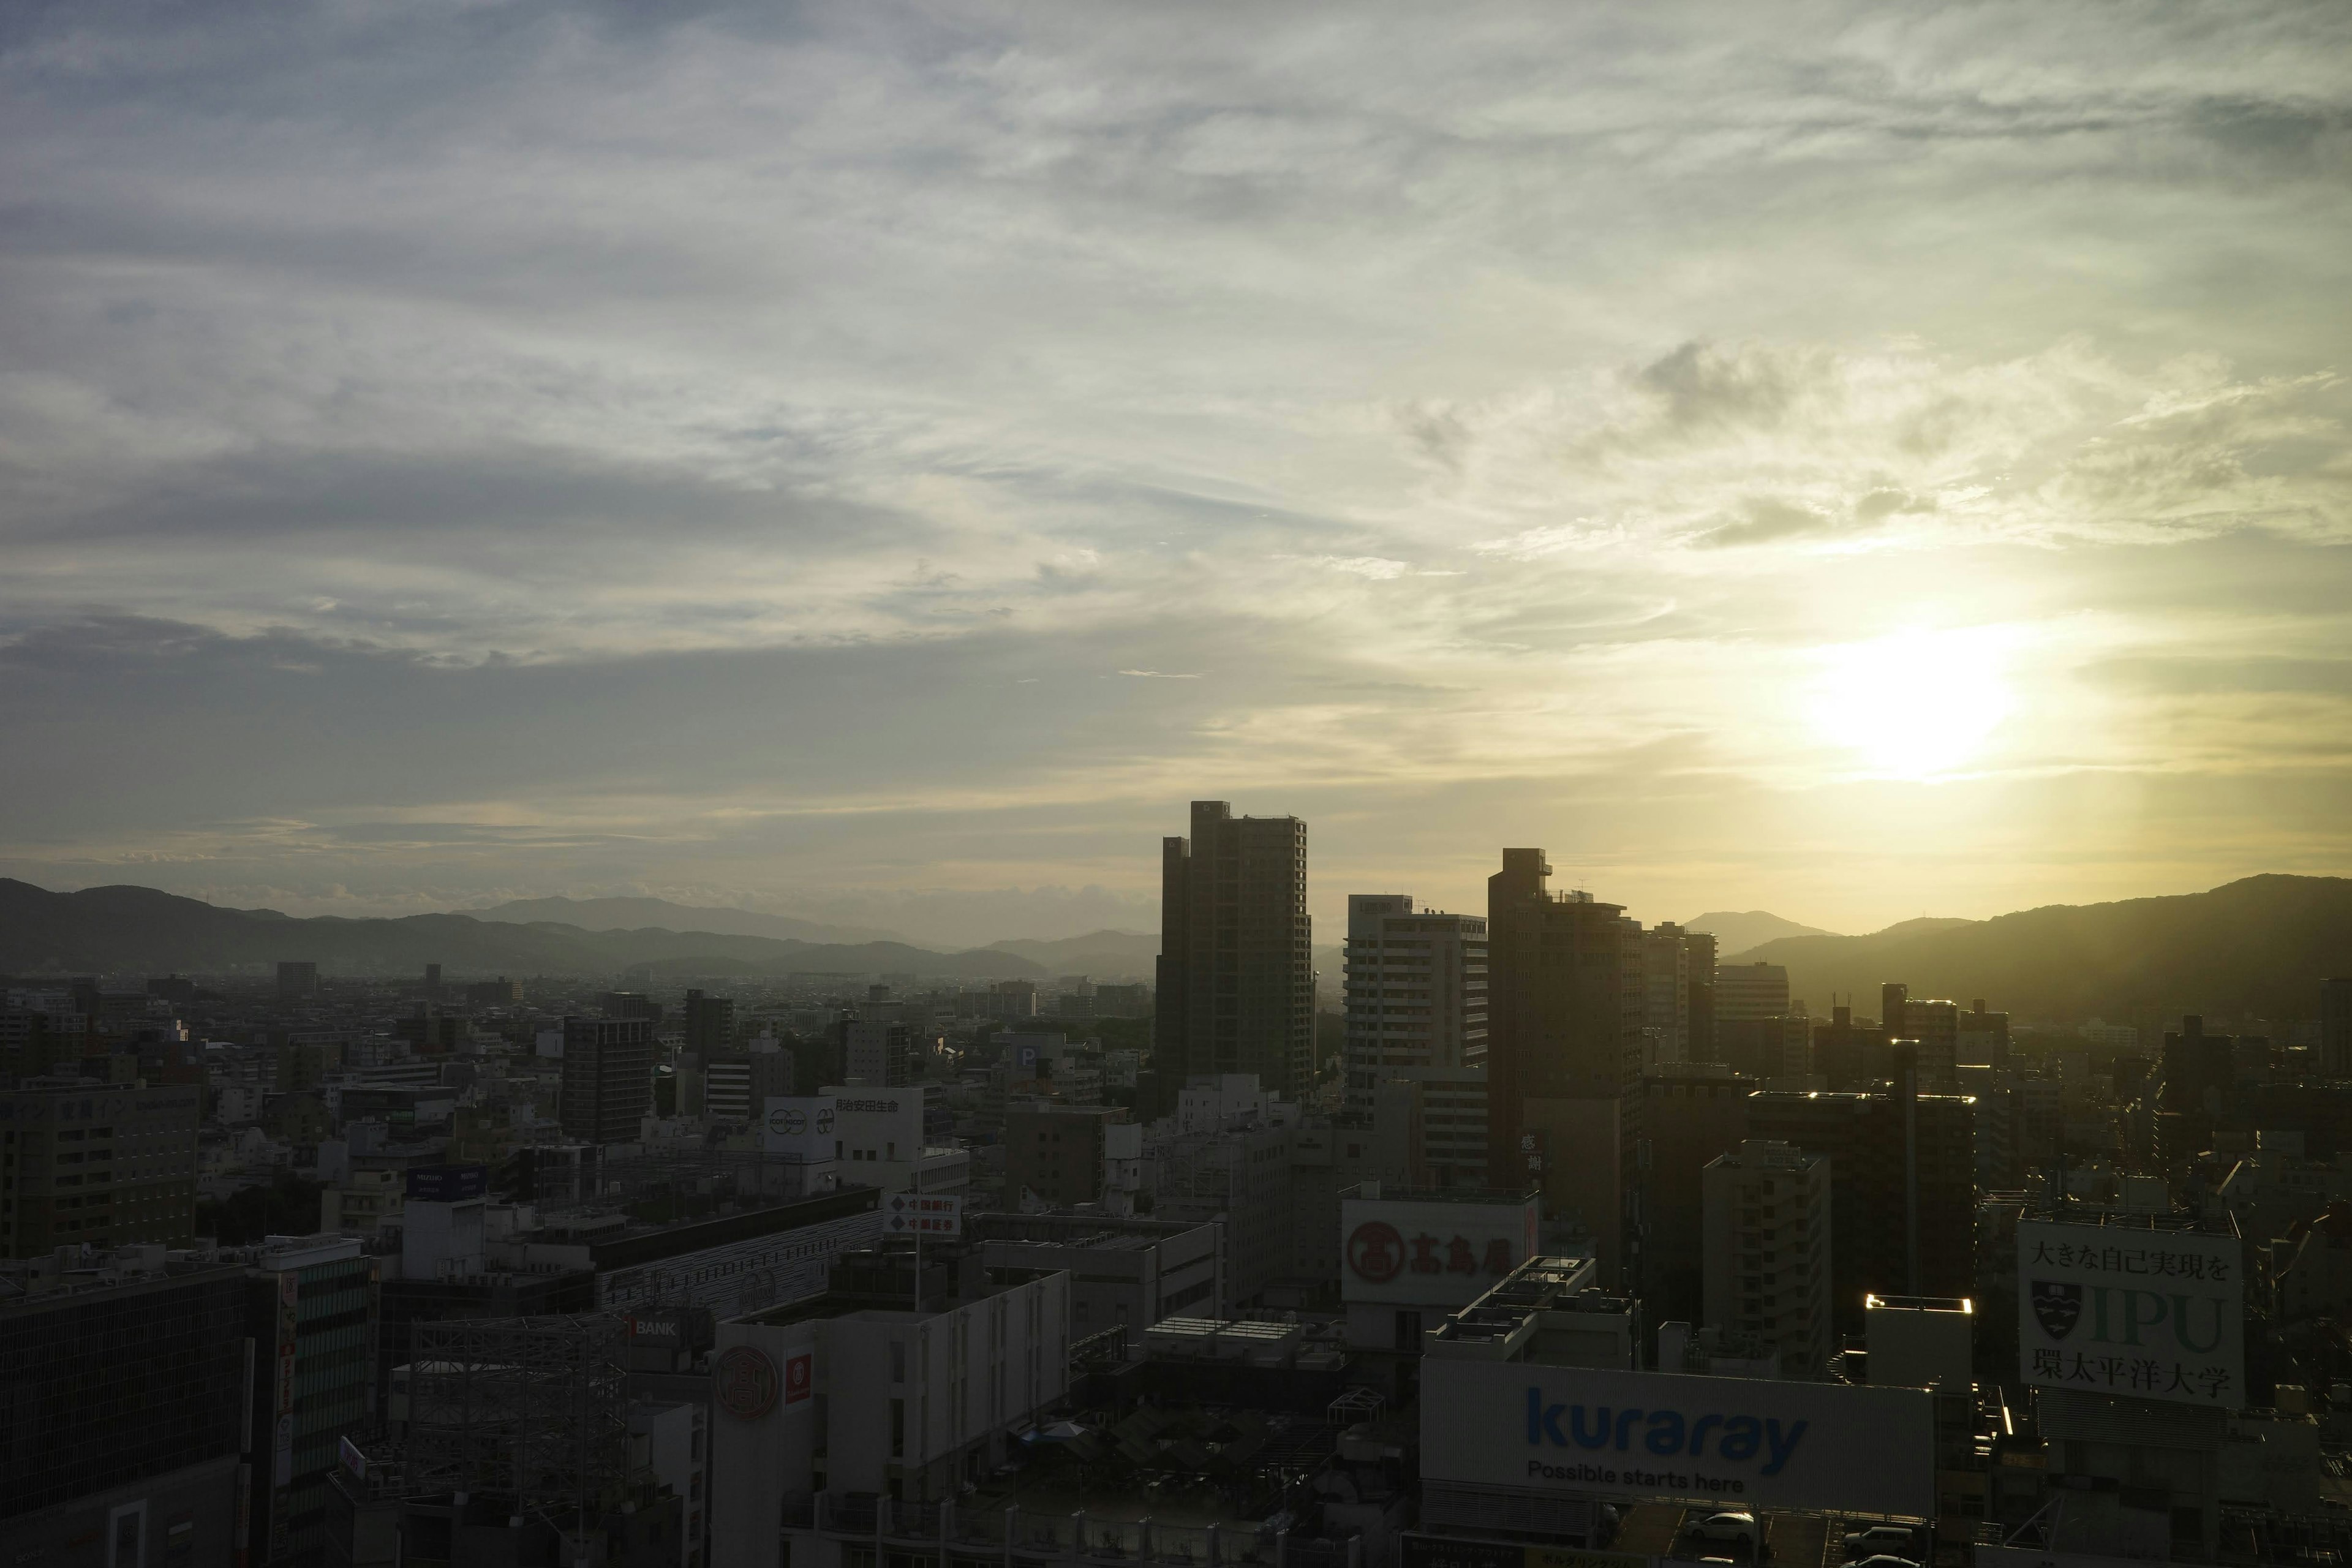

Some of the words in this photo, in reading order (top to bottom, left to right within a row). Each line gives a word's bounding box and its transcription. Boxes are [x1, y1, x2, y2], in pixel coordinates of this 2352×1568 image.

[1022, 1048, 1035, 1066] P
[1521, 1134, 1542, 1171] 感謝
[909, 1199, 953, 1212] 中国銀行
[2030, 1242, 2230, 1281] 大きな自己実現を
[636, 1321, 676, 1336] BANK
[2087, 1286, 2228, 1354] IPU
[2032, 1349, 2231, 1399] 環太平洋大学
[1528, 1387, 1808, 1476] kuraray
[1528, 1460, 1616, 1484] Possible
[1623, 1470, 1689, 1488] starts
[1695, 1472, 1745, 1493] here
